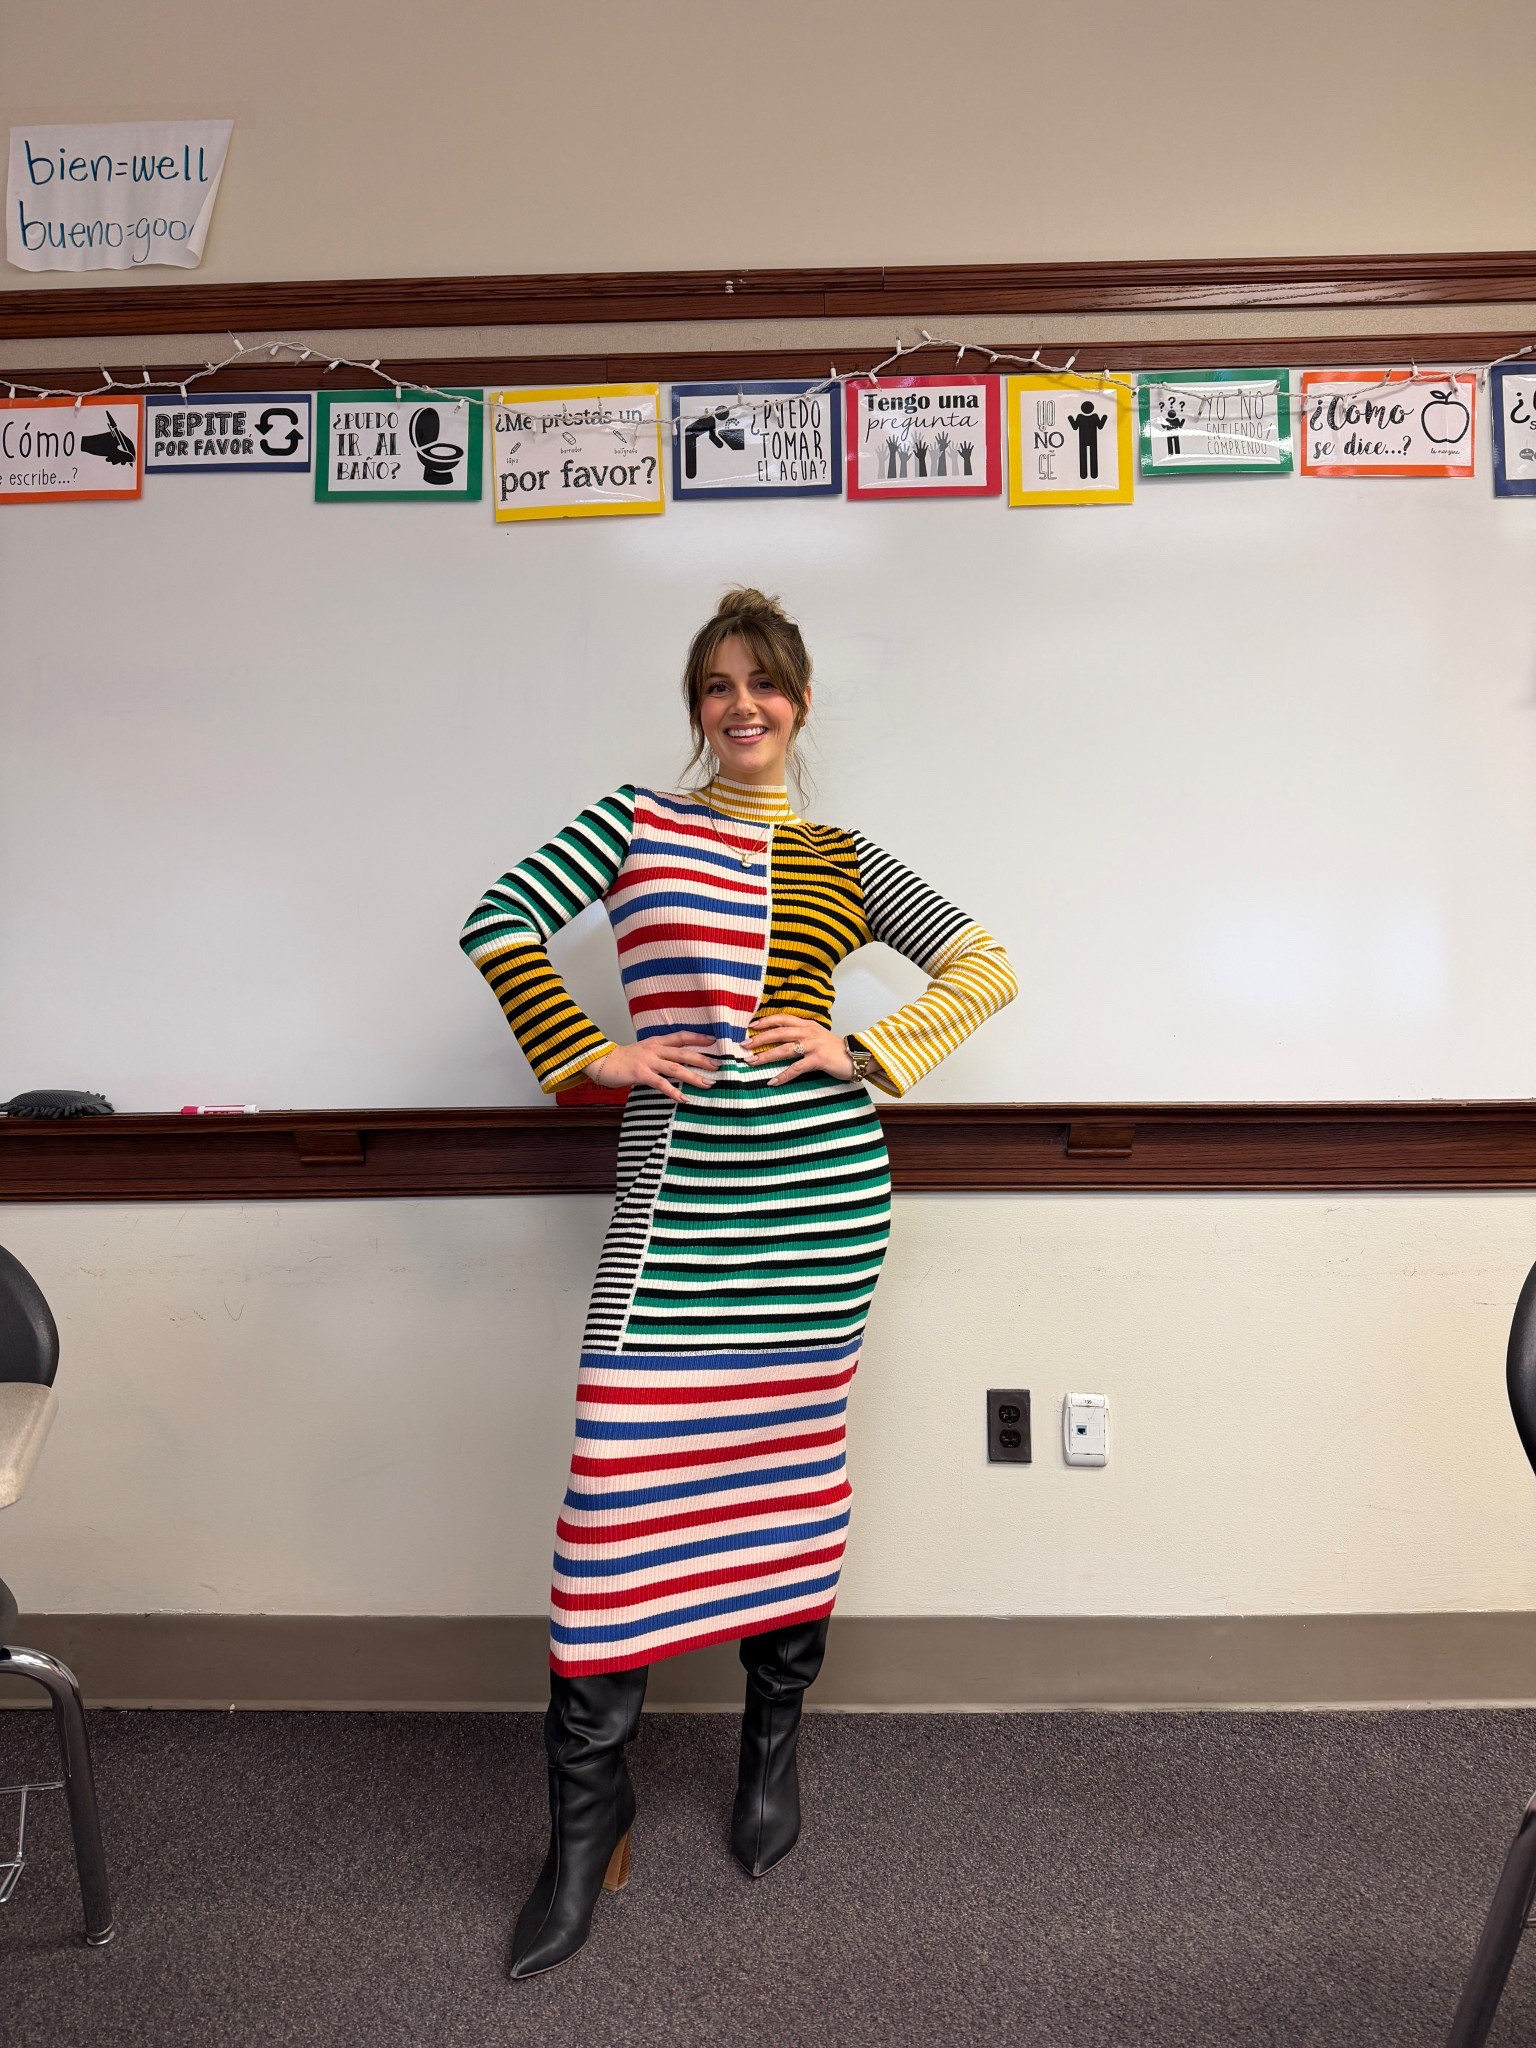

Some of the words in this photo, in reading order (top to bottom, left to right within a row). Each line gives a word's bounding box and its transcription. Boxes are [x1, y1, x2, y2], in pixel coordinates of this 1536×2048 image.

[24, 140, 209, 186] bien=well
[18, 199, 195, 264] bueno=goo
[863, 393, 931, 414] Tengo
[938, 394, 980, 409] una
[1203, 391, 1226, 421] YO
[1240, 390, 1264, 420] NO
[1309, 395, 1415, 431] ¿Cómo
[333, 411, 399, 430] ¿PUEDO
[495, 413, 533, 433] ¿Me
[750, 399, 821, 435] ¿PUEDO
[865, 411, 979, 443] pregunta
[154, 440, 189, 457] POR
[194, 438, 254, 456] FAVOR
[336, 433, 362, 456] IR
[373, 433, 401, 456] AL
[760, 429, 823, 460] TOMAR
[1033, 431, 1065, 449] NO
[1313, 441, 1335, 459] se
[1343, 432, 1412, 456] dice...?
[9, 467, 78, 486] escribe...?
[336, 456, 401, 480] BAÑO?
[499, 470, 551, 501] por
[560, 456, 657, 489] favor?
[757, 460, 771, 481] EL
[780, 459, 827, 481] AGUA?
